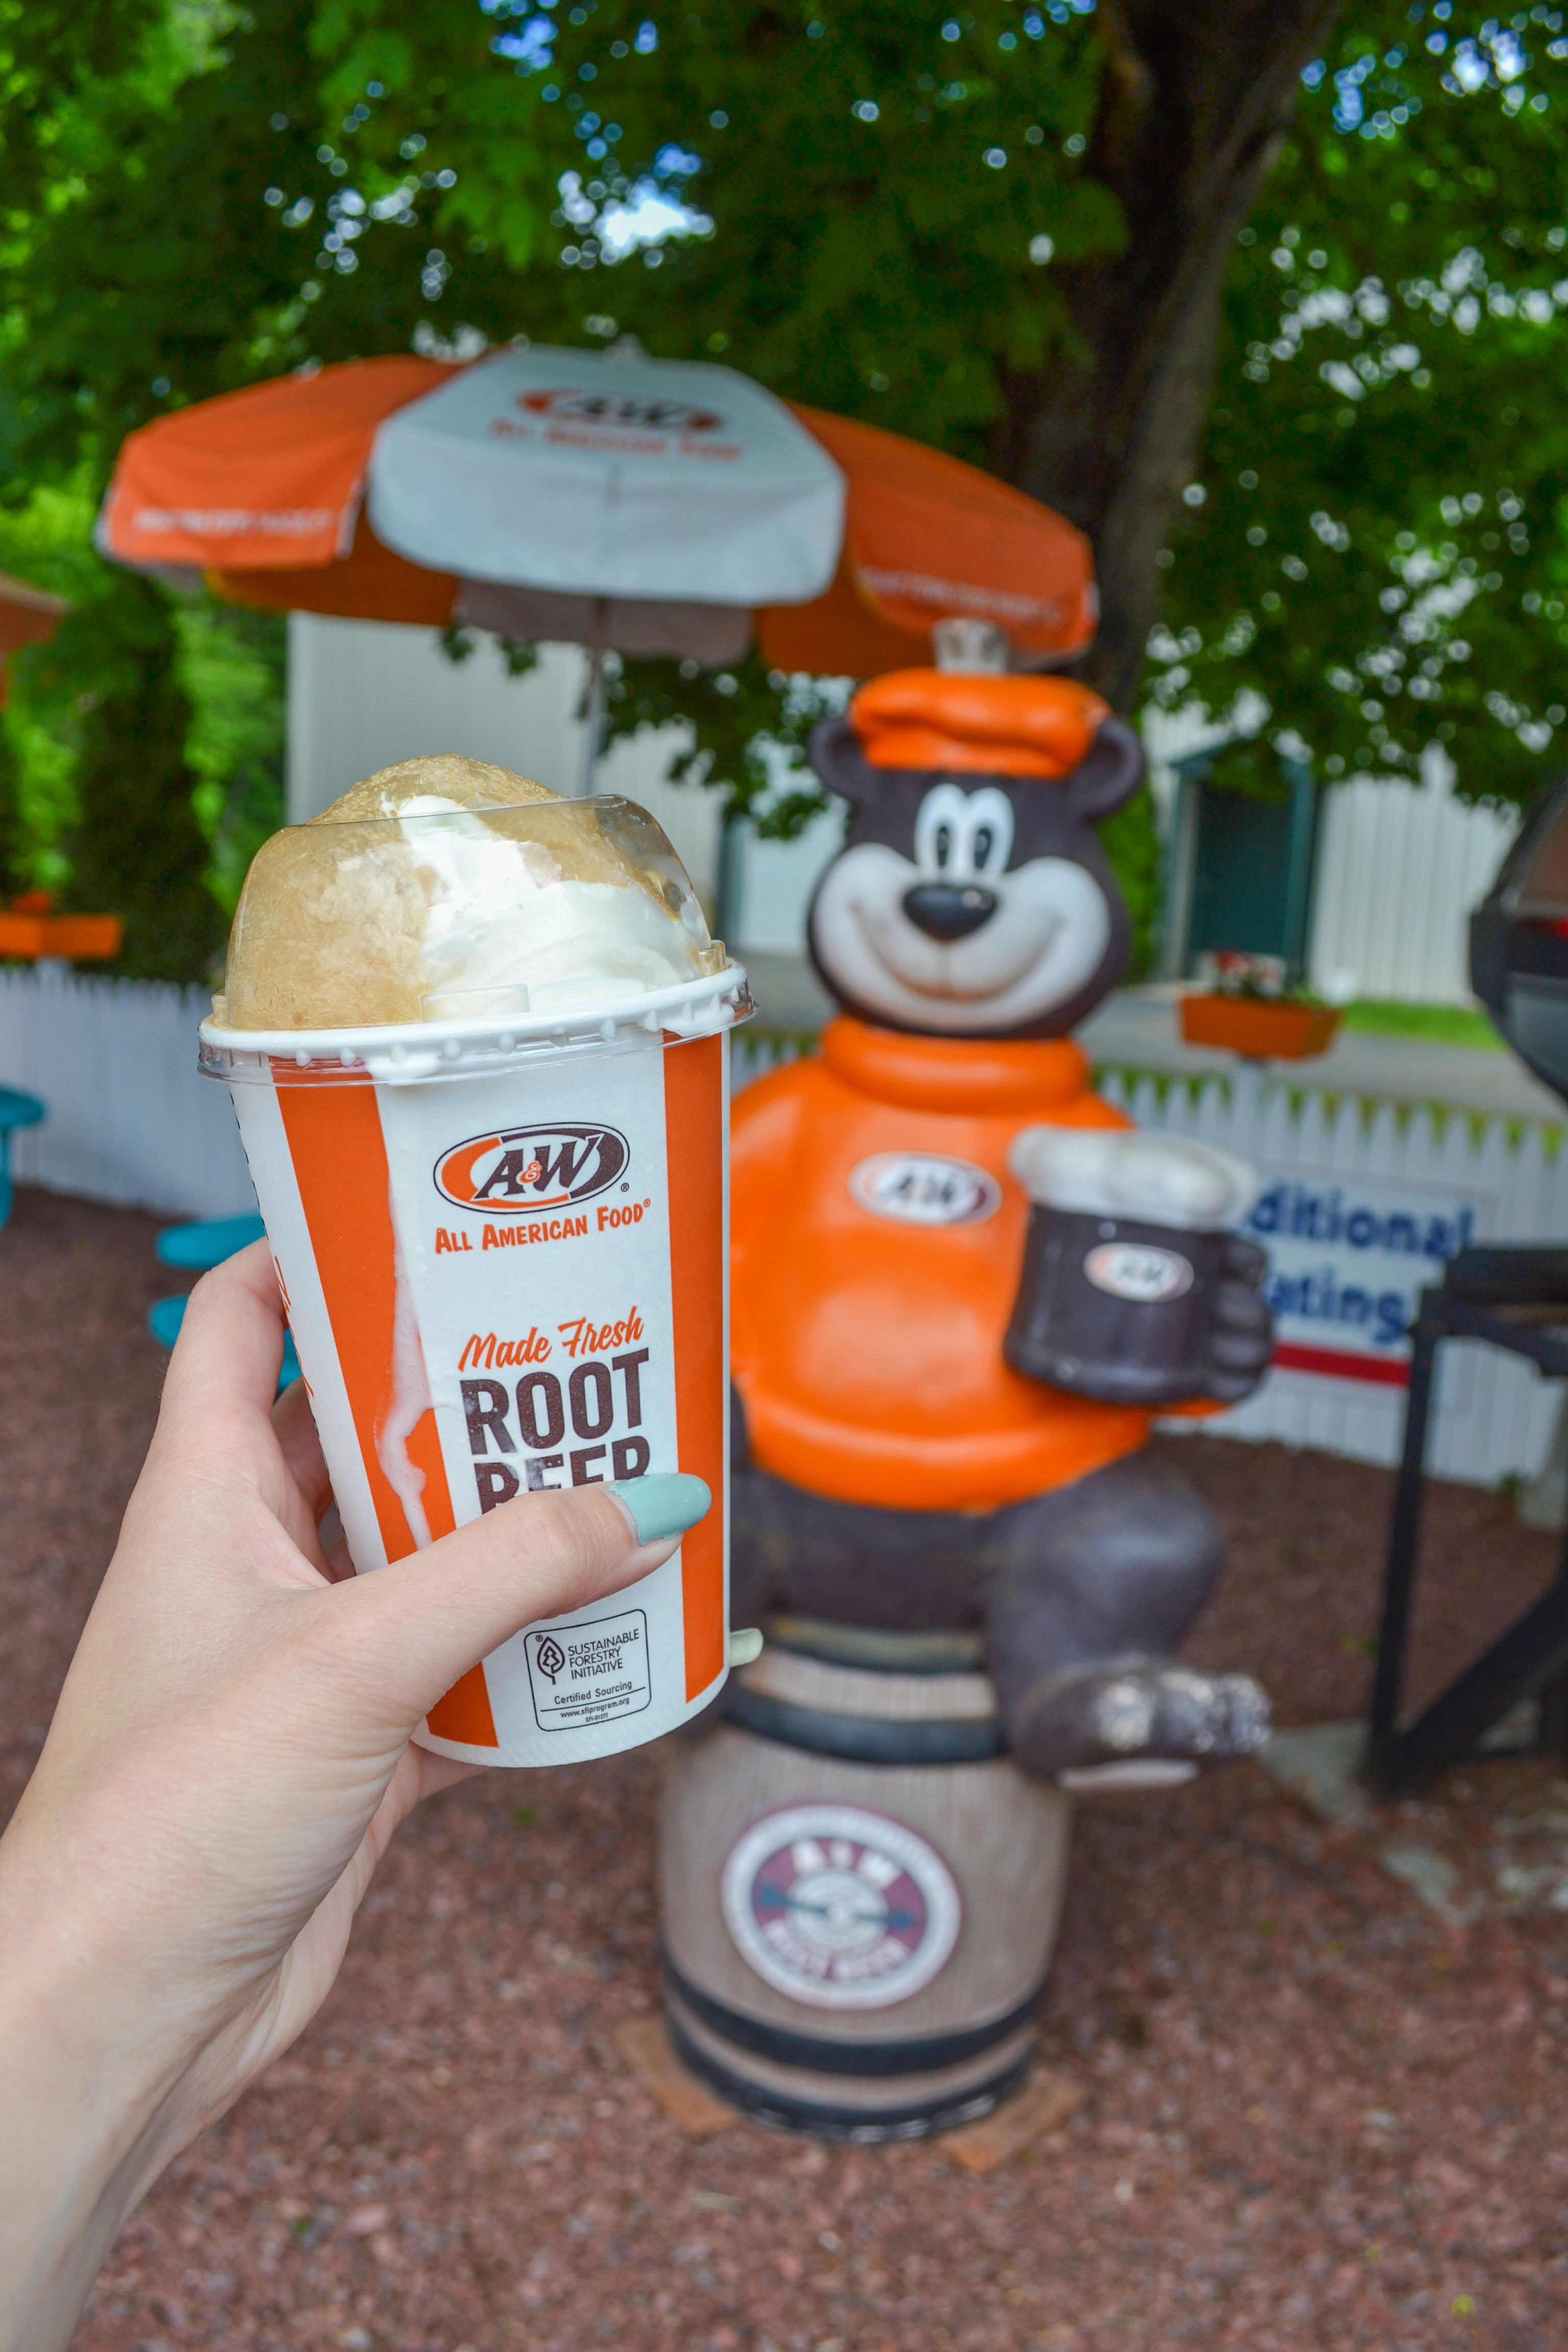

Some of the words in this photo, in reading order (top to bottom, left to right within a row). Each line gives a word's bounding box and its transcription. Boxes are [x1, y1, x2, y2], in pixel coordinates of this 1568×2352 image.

[472, 1134, 604, 1200] A&W
[1249, 1183, 1474, 1260] ditional
[1267, 1268, 1406, 1347] ating
[457, 1326, 552, 1373] Made
[557, 1305, 644, 1358] Fresh
[459, 1347, 650, 1456] ROOT
[568, 1628, 640, 1657] SUSTAINABLE
[569, 1646, 621, 1668] FORESTRY
[571, 1658, 624, 1680] INITIATIVE
[554, 1690, 591, 1705] Certified
[595, 1681, 632, 1698] Sourcing
[560, 1697, 630, 1718] www.sfiprogram.org
[585, 1712, 608, 1723] SFI-01277
